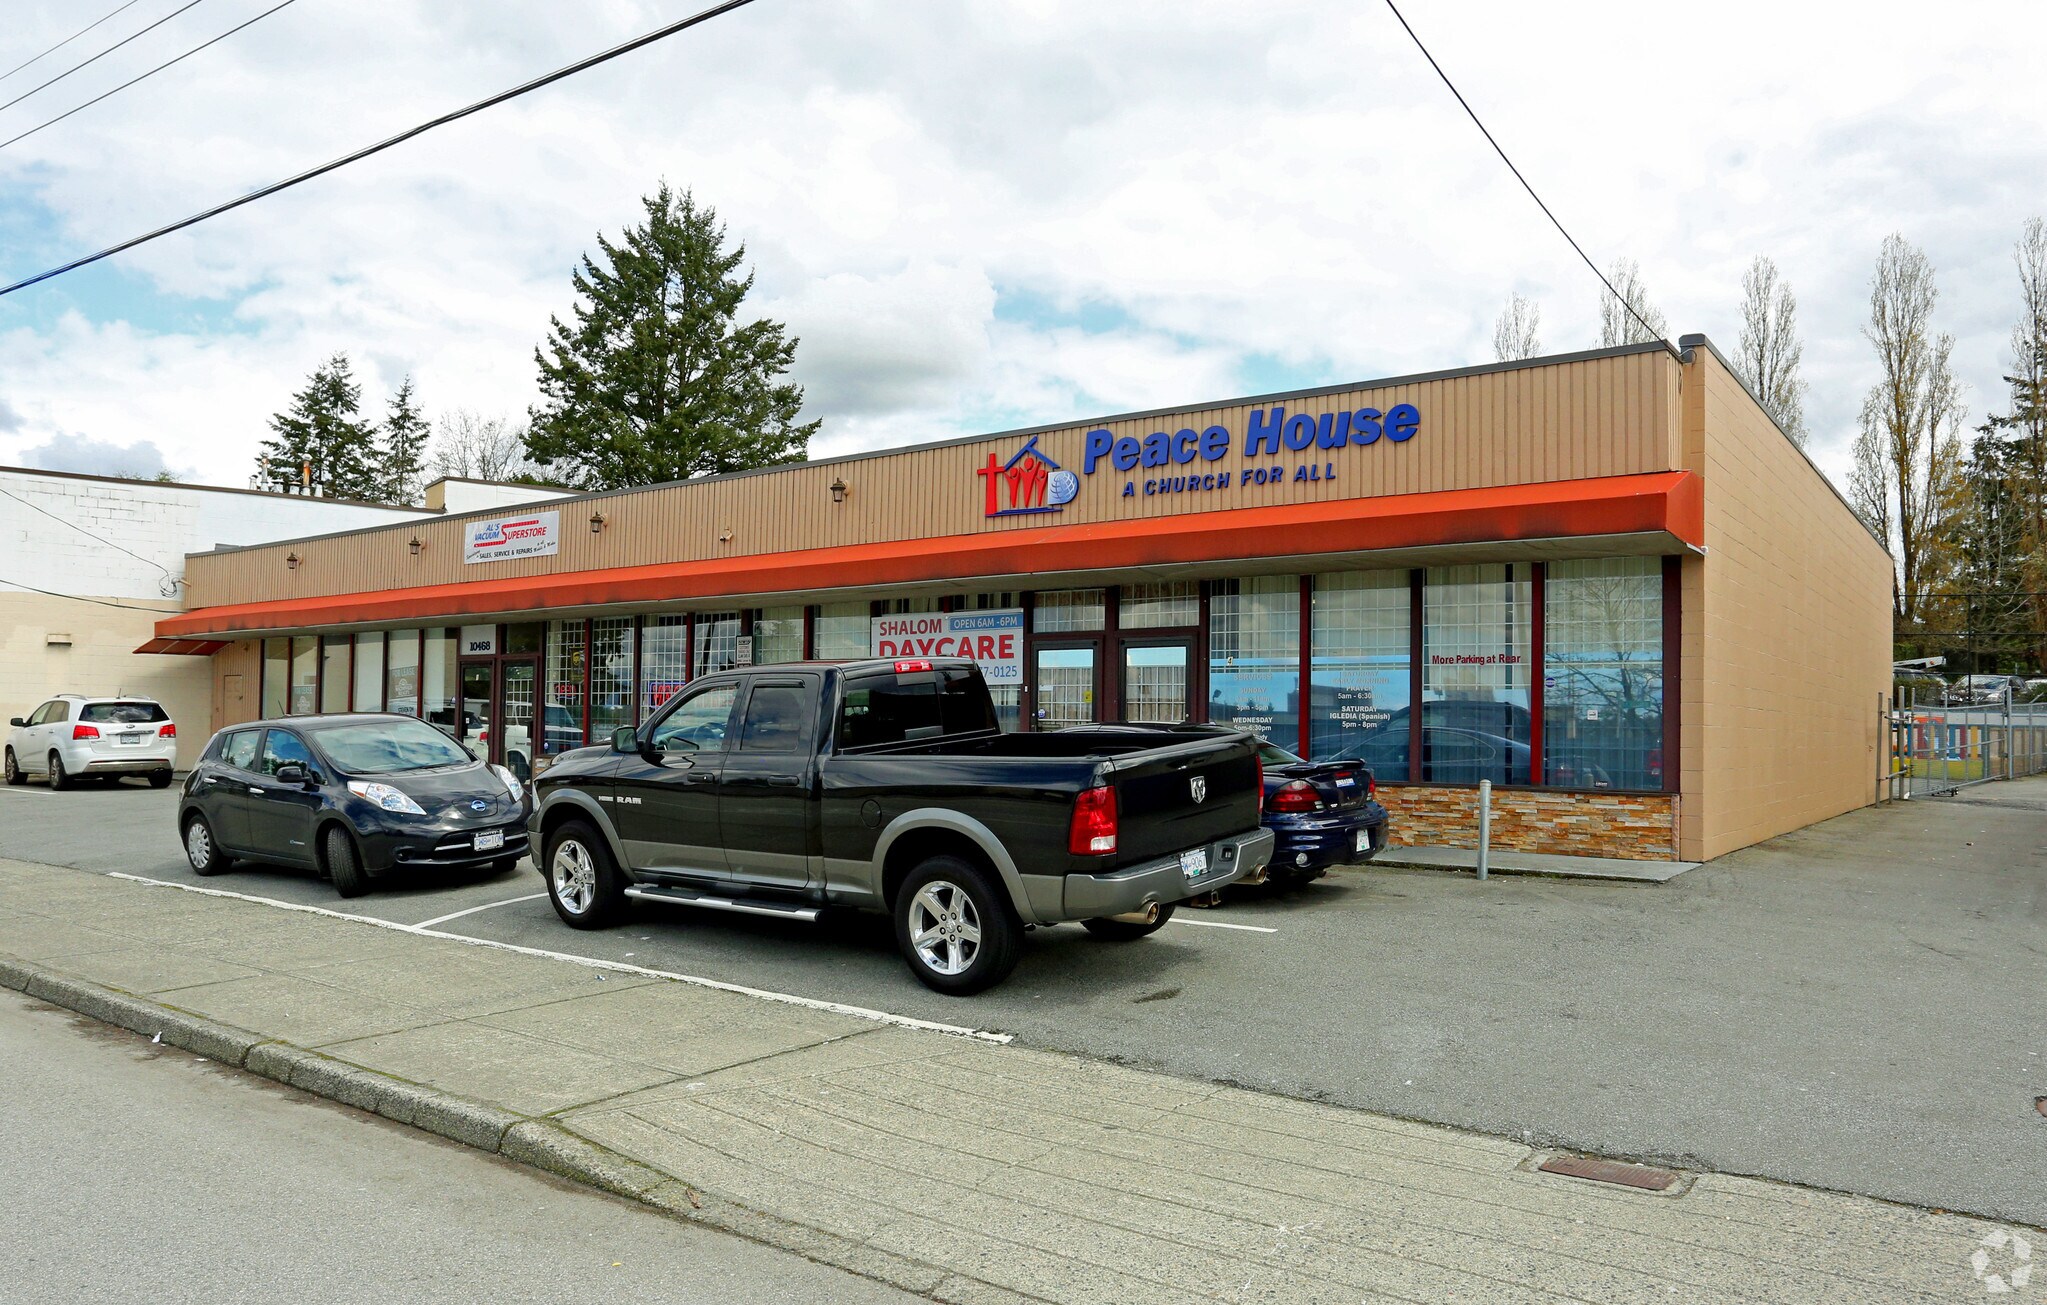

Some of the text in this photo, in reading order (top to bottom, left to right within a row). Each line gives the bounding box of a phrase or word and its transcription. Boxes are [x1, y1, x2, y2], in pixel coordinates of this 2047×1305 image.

[1083, 403, 1421, 475] Peace House
[1122, 462, 1337, 498] A CHURCH FOR ALL
[486, 523, 500, 531] AL'S
[474, 531, 500, 541] VACUUM
[479, 552, 493, 560] SALES,
[494, 549, 510, 558] SERVICE
[516, 547, 533, 555] REPAIRS
[879, 616, 1018, 636] SHALOM OPEN 6AM -6PM
[470, 641, 491, 651] 10468
[879, 634, 1015, 660] DAYCARE
[1432, 653, 1521, 666] More Parking at Rear
[1232, 716, 1273, 724] WEDNESDAY
[1358, 712, 1391, 721] (Spanish)
[616, 796, 642, 805] RAM
